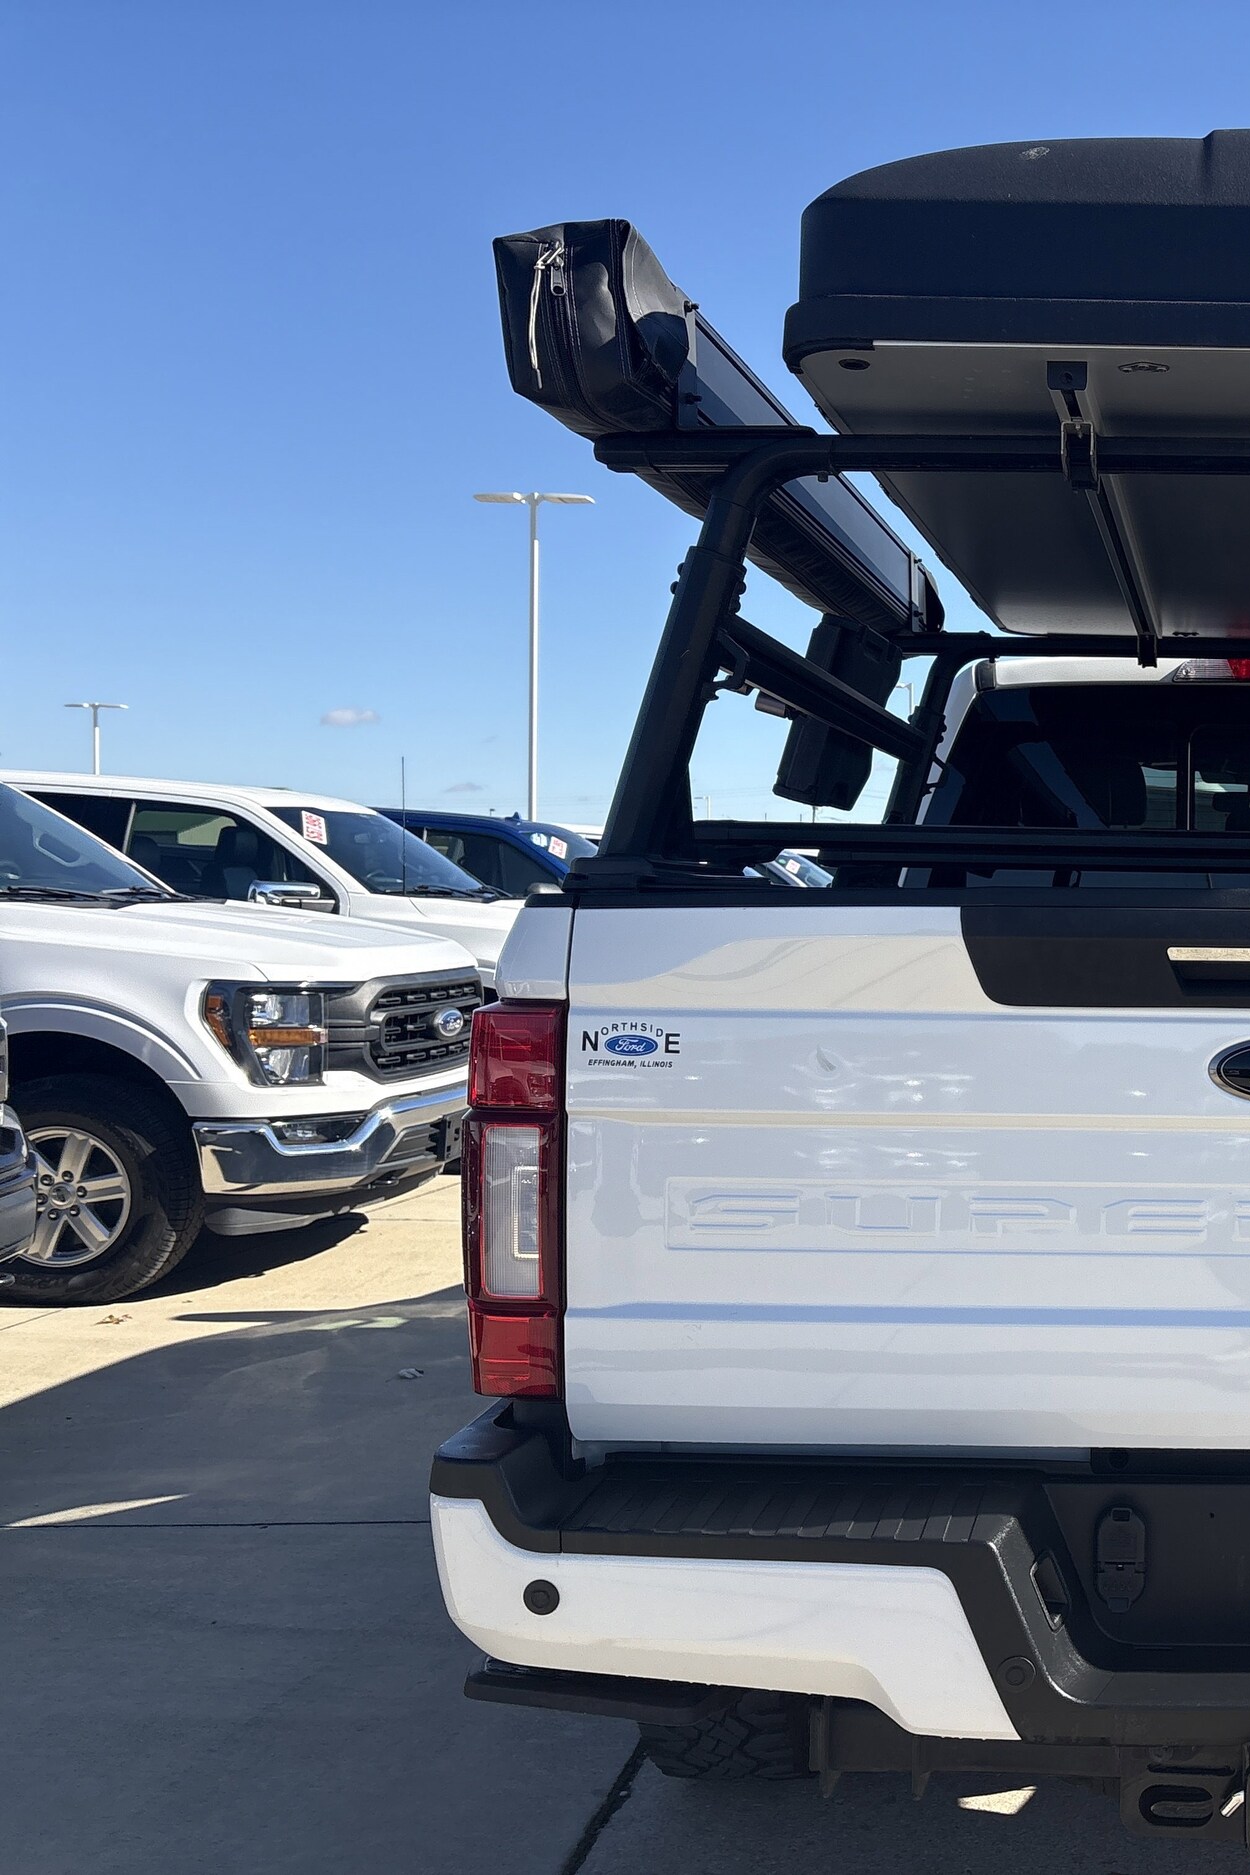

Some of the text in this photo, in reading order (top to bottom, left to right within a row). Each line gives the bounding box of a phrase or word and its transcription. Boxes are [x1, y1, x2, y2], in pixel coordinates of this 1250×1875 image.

[581, 1021, 681, 1054] NORTHSIDE
[614, 1037, 647, 1053] Ford
[588, 1058, 673, 1069] EFFINGHAM, ILLINOIS
